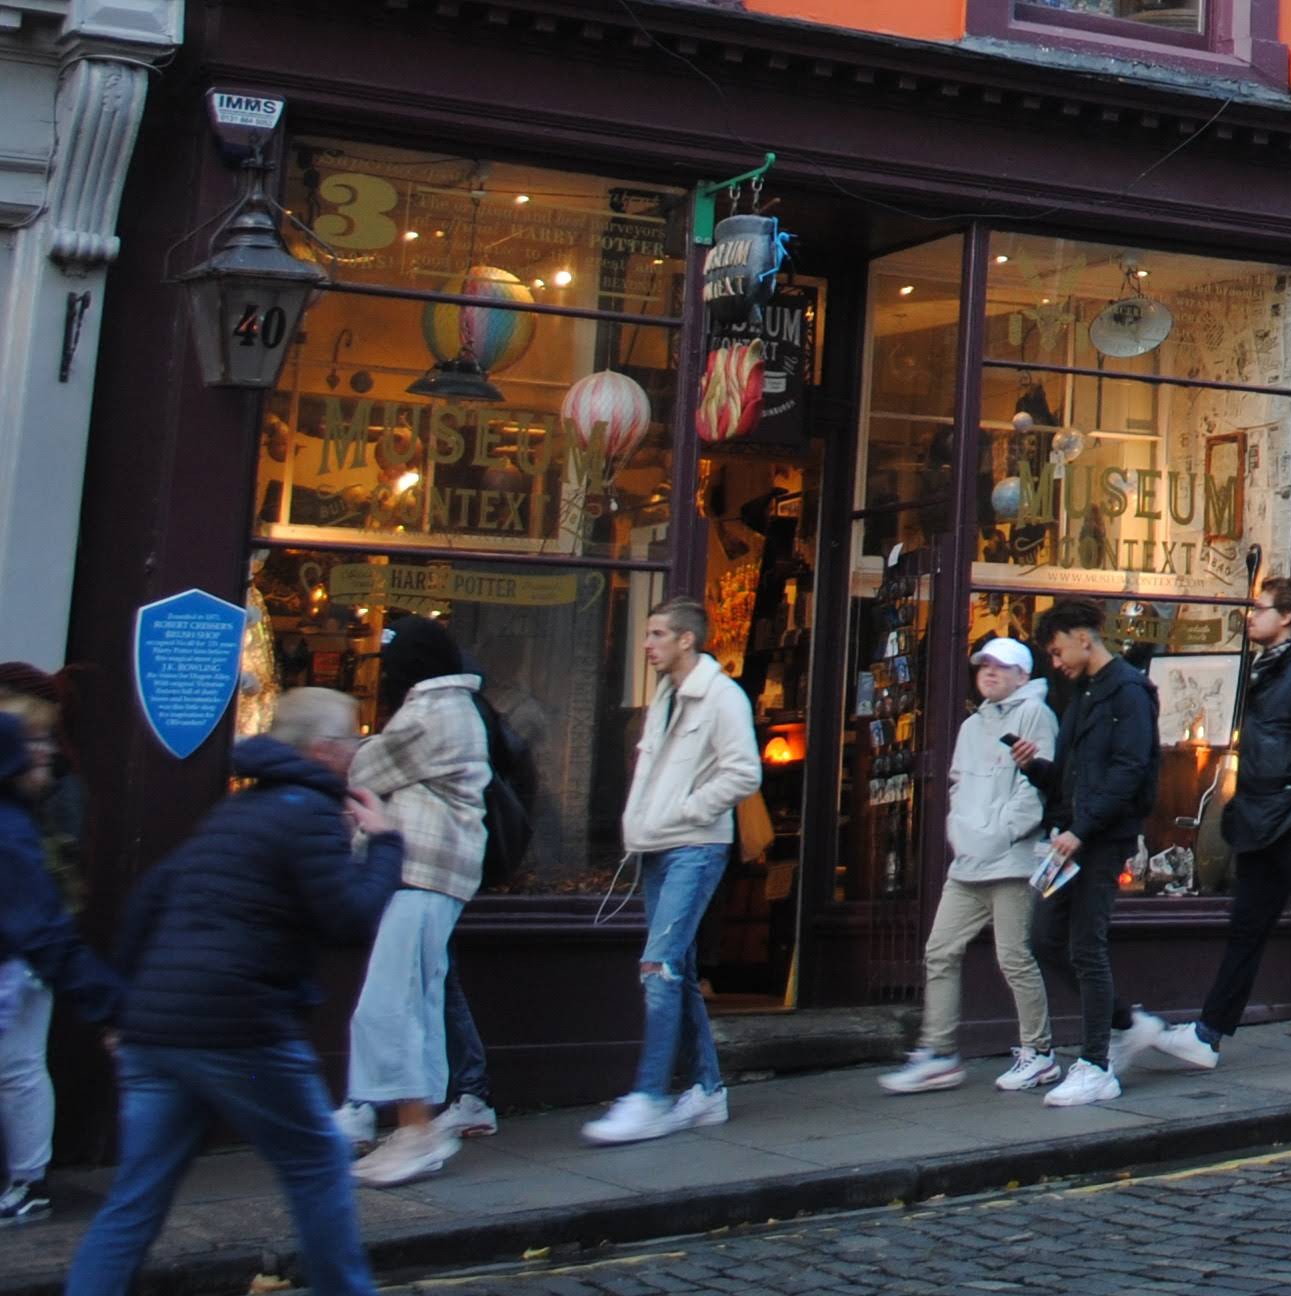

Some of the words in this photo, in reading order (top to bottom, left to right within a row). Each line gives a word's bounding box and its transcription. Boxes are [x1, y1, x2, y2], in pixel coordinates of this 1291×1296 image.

[219, 95, 277, 114] IMMS
[313, 173, 398, 251] 3
[589, 235, 665, 258] POTTER
[233, 304, 287, 349] 40
[318, 397, 608, 495] MUSEUM
[370, 484, 551, 532] CONTEXT
[1017, 460, 1240, 541] MUSEUM
[1059, 534, 1197, 575] CONTEXT
[453, 575, 518, 599] POTTER
